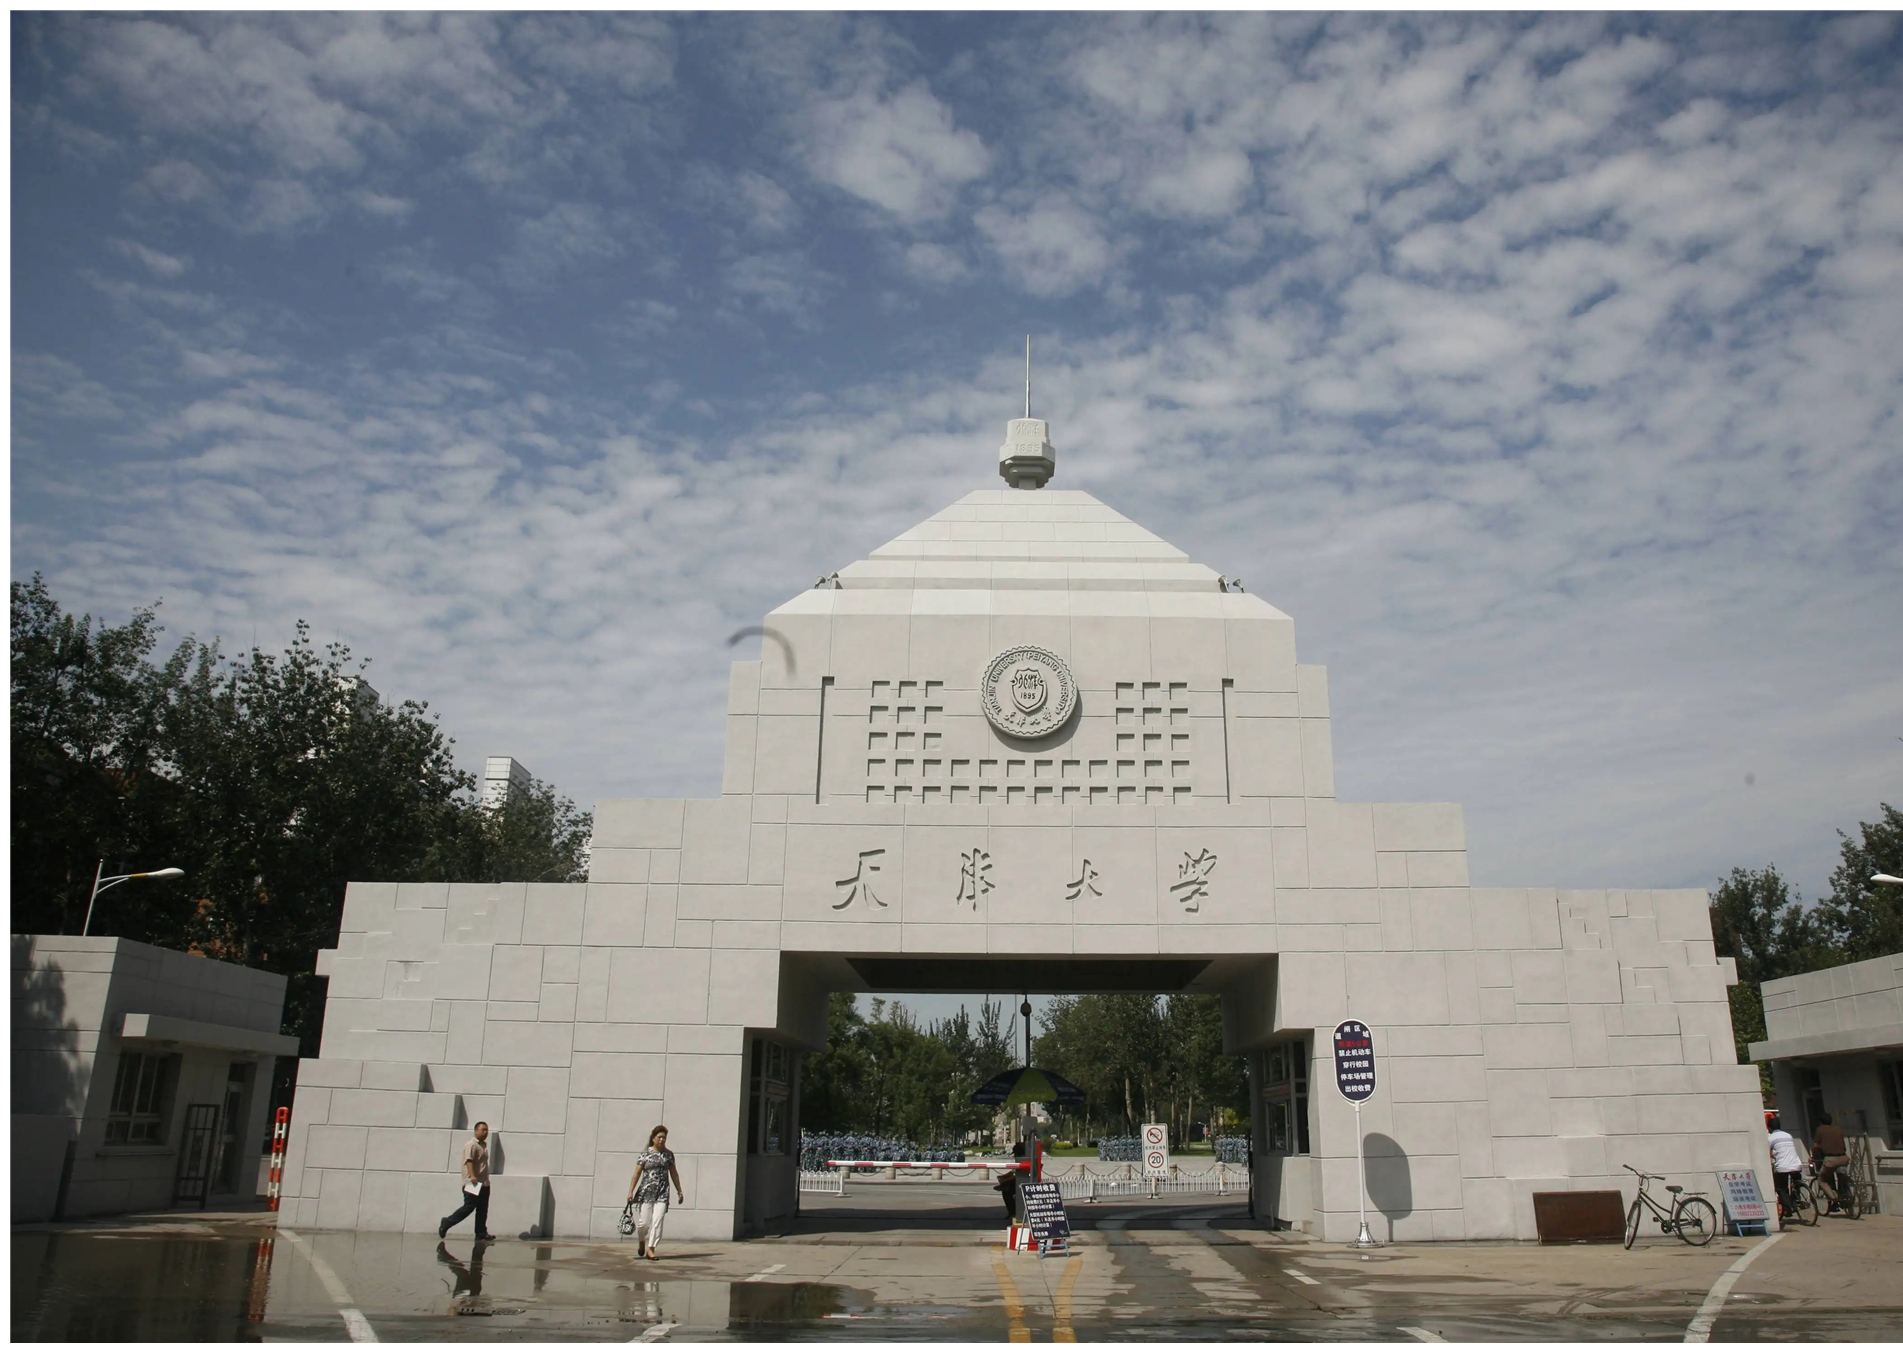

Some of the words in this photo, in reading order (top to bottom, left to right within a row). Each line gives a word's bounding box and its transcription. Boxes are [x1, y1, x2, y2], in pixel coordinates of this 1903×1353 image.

[1020, 692, 1036, 700] 1895
[832, 847, 1217, 914] 天津大学
[1338, 1048, 1371, 1057] 禁止机动车
[1340, 1072, 1373, 1081] 停车场管理
[1344, 1084, 1371, 1093] 出校收费
[1151, 1155, 1161, 1164] 20
